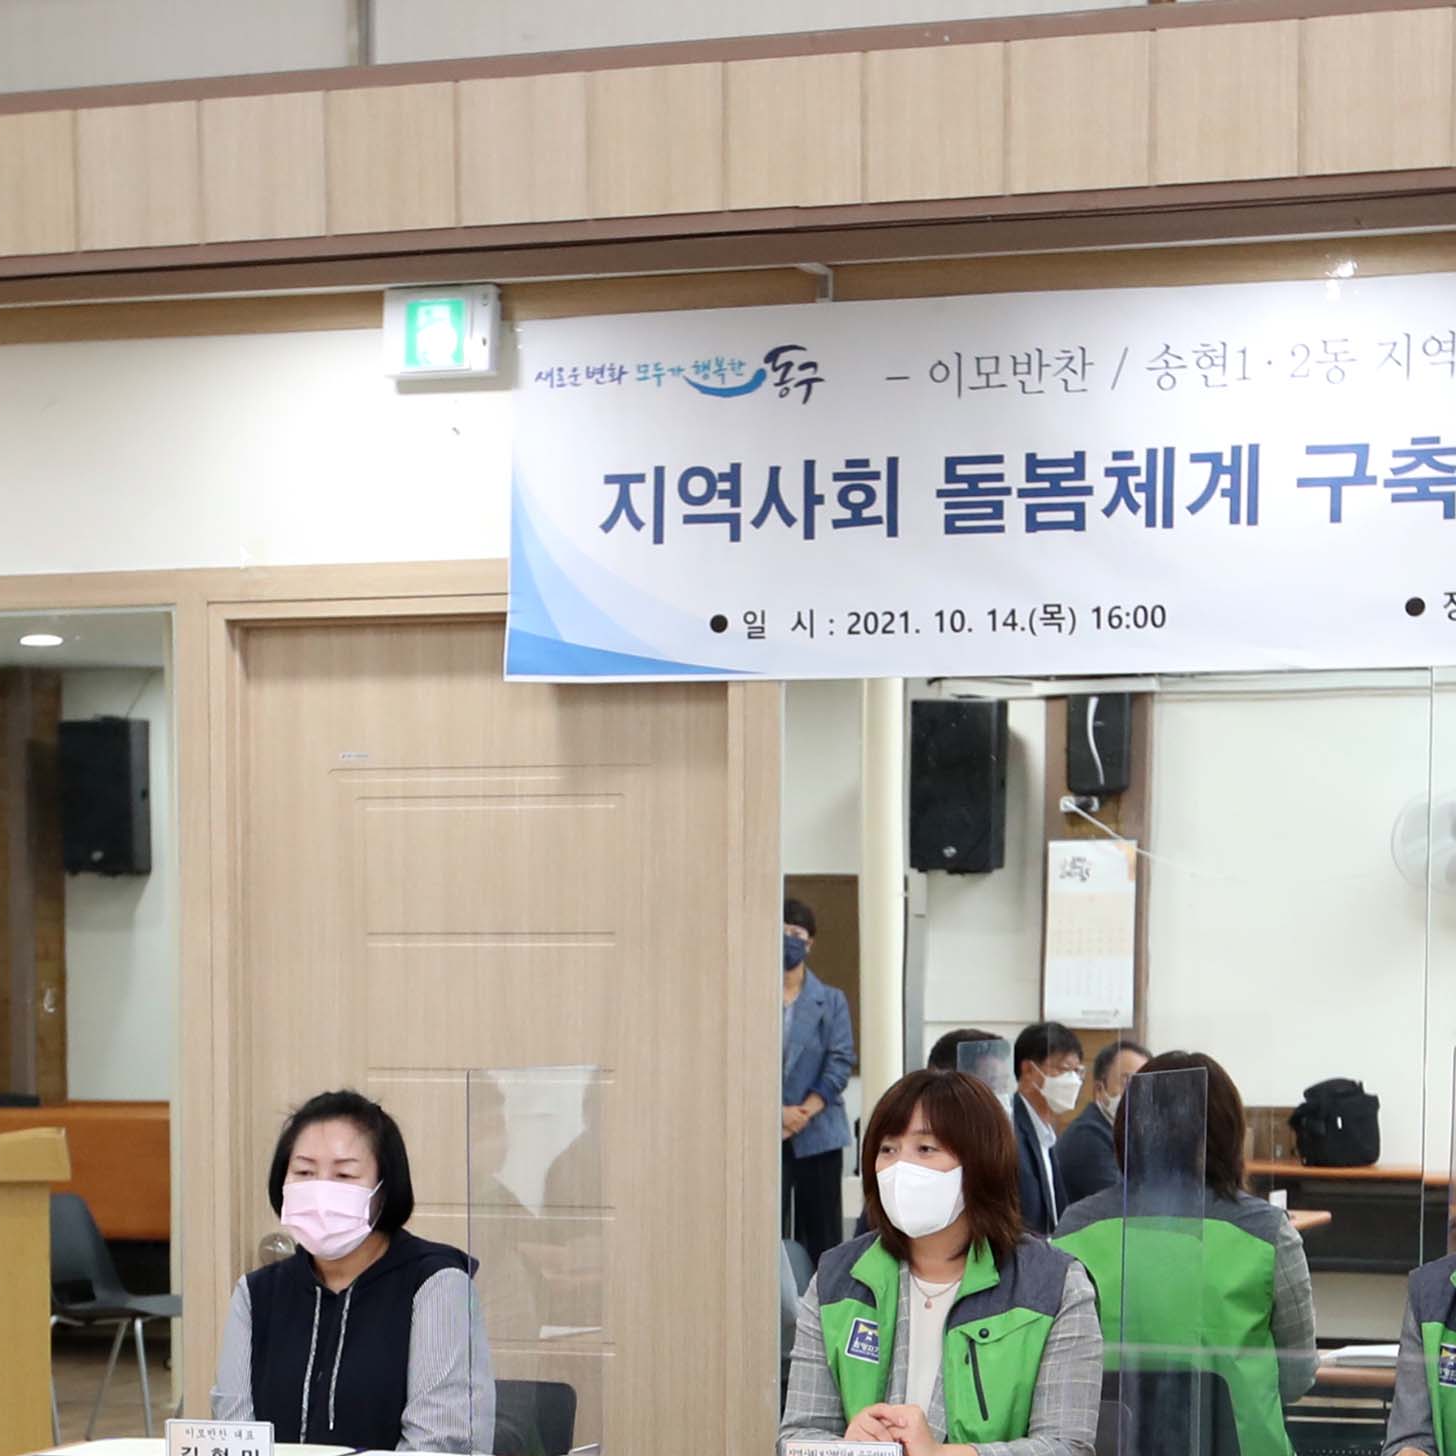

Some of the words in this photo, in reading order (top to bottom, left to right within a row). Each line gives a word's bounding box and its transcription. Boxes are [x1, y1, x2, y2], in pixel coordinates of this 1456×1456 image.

[635, 363, 685, 387] 모두가
[693, 356, 747, 385] 행복한
[928, 345, 1095, 399] 이모반찬
[600, 456, 901, 544] 지역사회
[935, 444, 1261, 532] 돌봄체계
[846, 610, 922, 636] 2021.
[934, 609, 973, 634] 10.
[986, 604, 1078, 636] 14.(목)
[1091, 604, 1168, 632] 16:00
